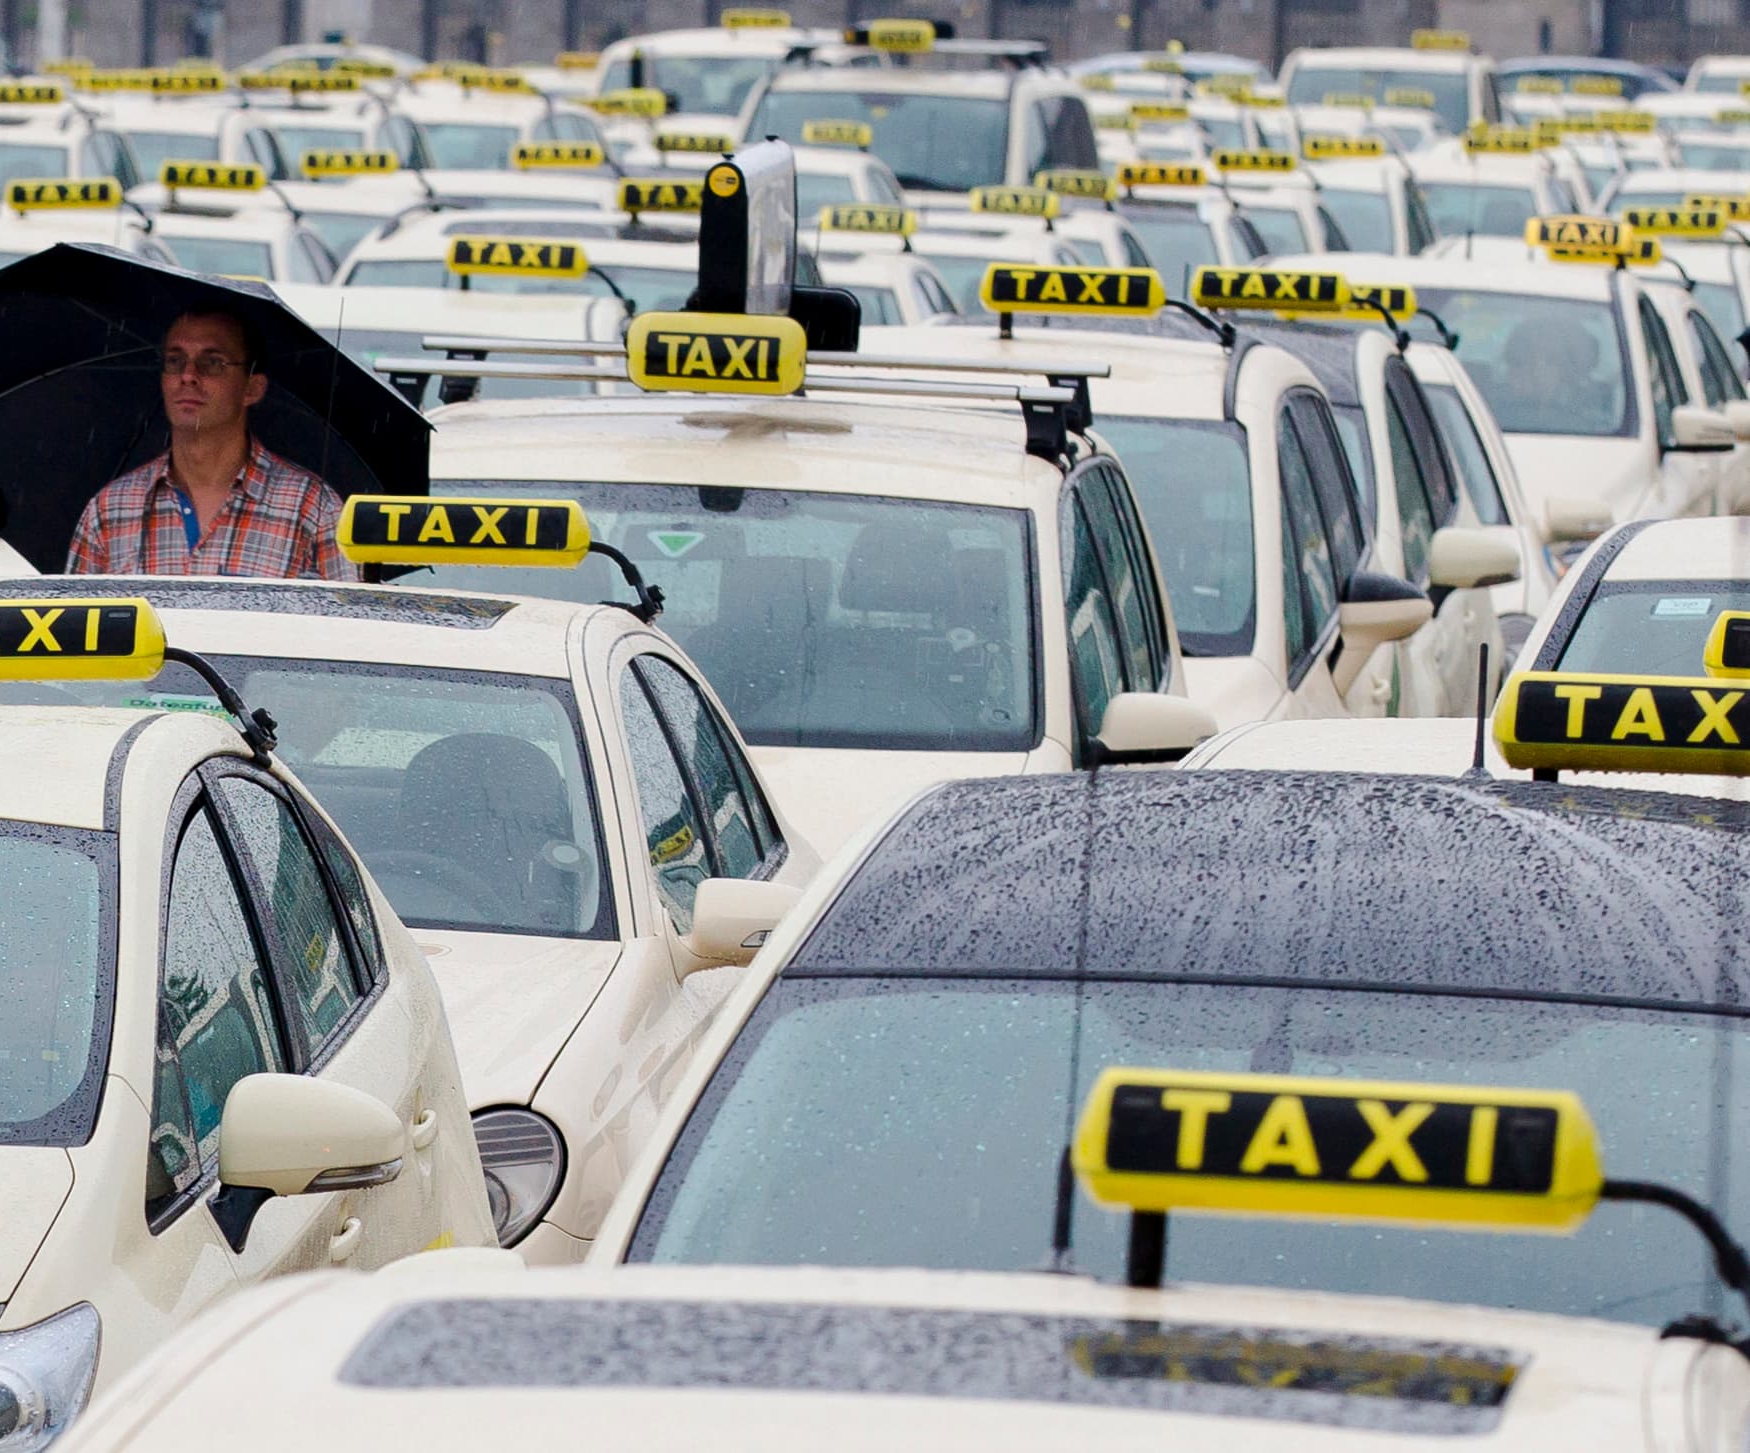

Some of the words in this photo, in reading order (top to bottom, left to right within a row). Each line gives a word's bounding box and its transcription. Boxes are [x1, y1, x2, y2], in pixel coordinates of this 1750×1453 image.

[178, 168, 246, 186] TAXI
[26, 186, 99, 202] TAXI
[985, 193, 1043, 211] TAXI
[837, 210, 901, 231] TAXI
[1638, 212, 1709, 227] TAXI
[1548, 222, 1614, 245] TAXI
[468, 241, 561, 269] TAXI
[1010, 271, 1130, 304] TAXI
[1215, 273, 1320, 299] TAXI
[658, 335, 769, 378] TAXI
[379, 505, 539, 545] TAXI
[1554, 685, 1746, 744] TAX
[1161, 1089, 1499, 1184] TAXI
